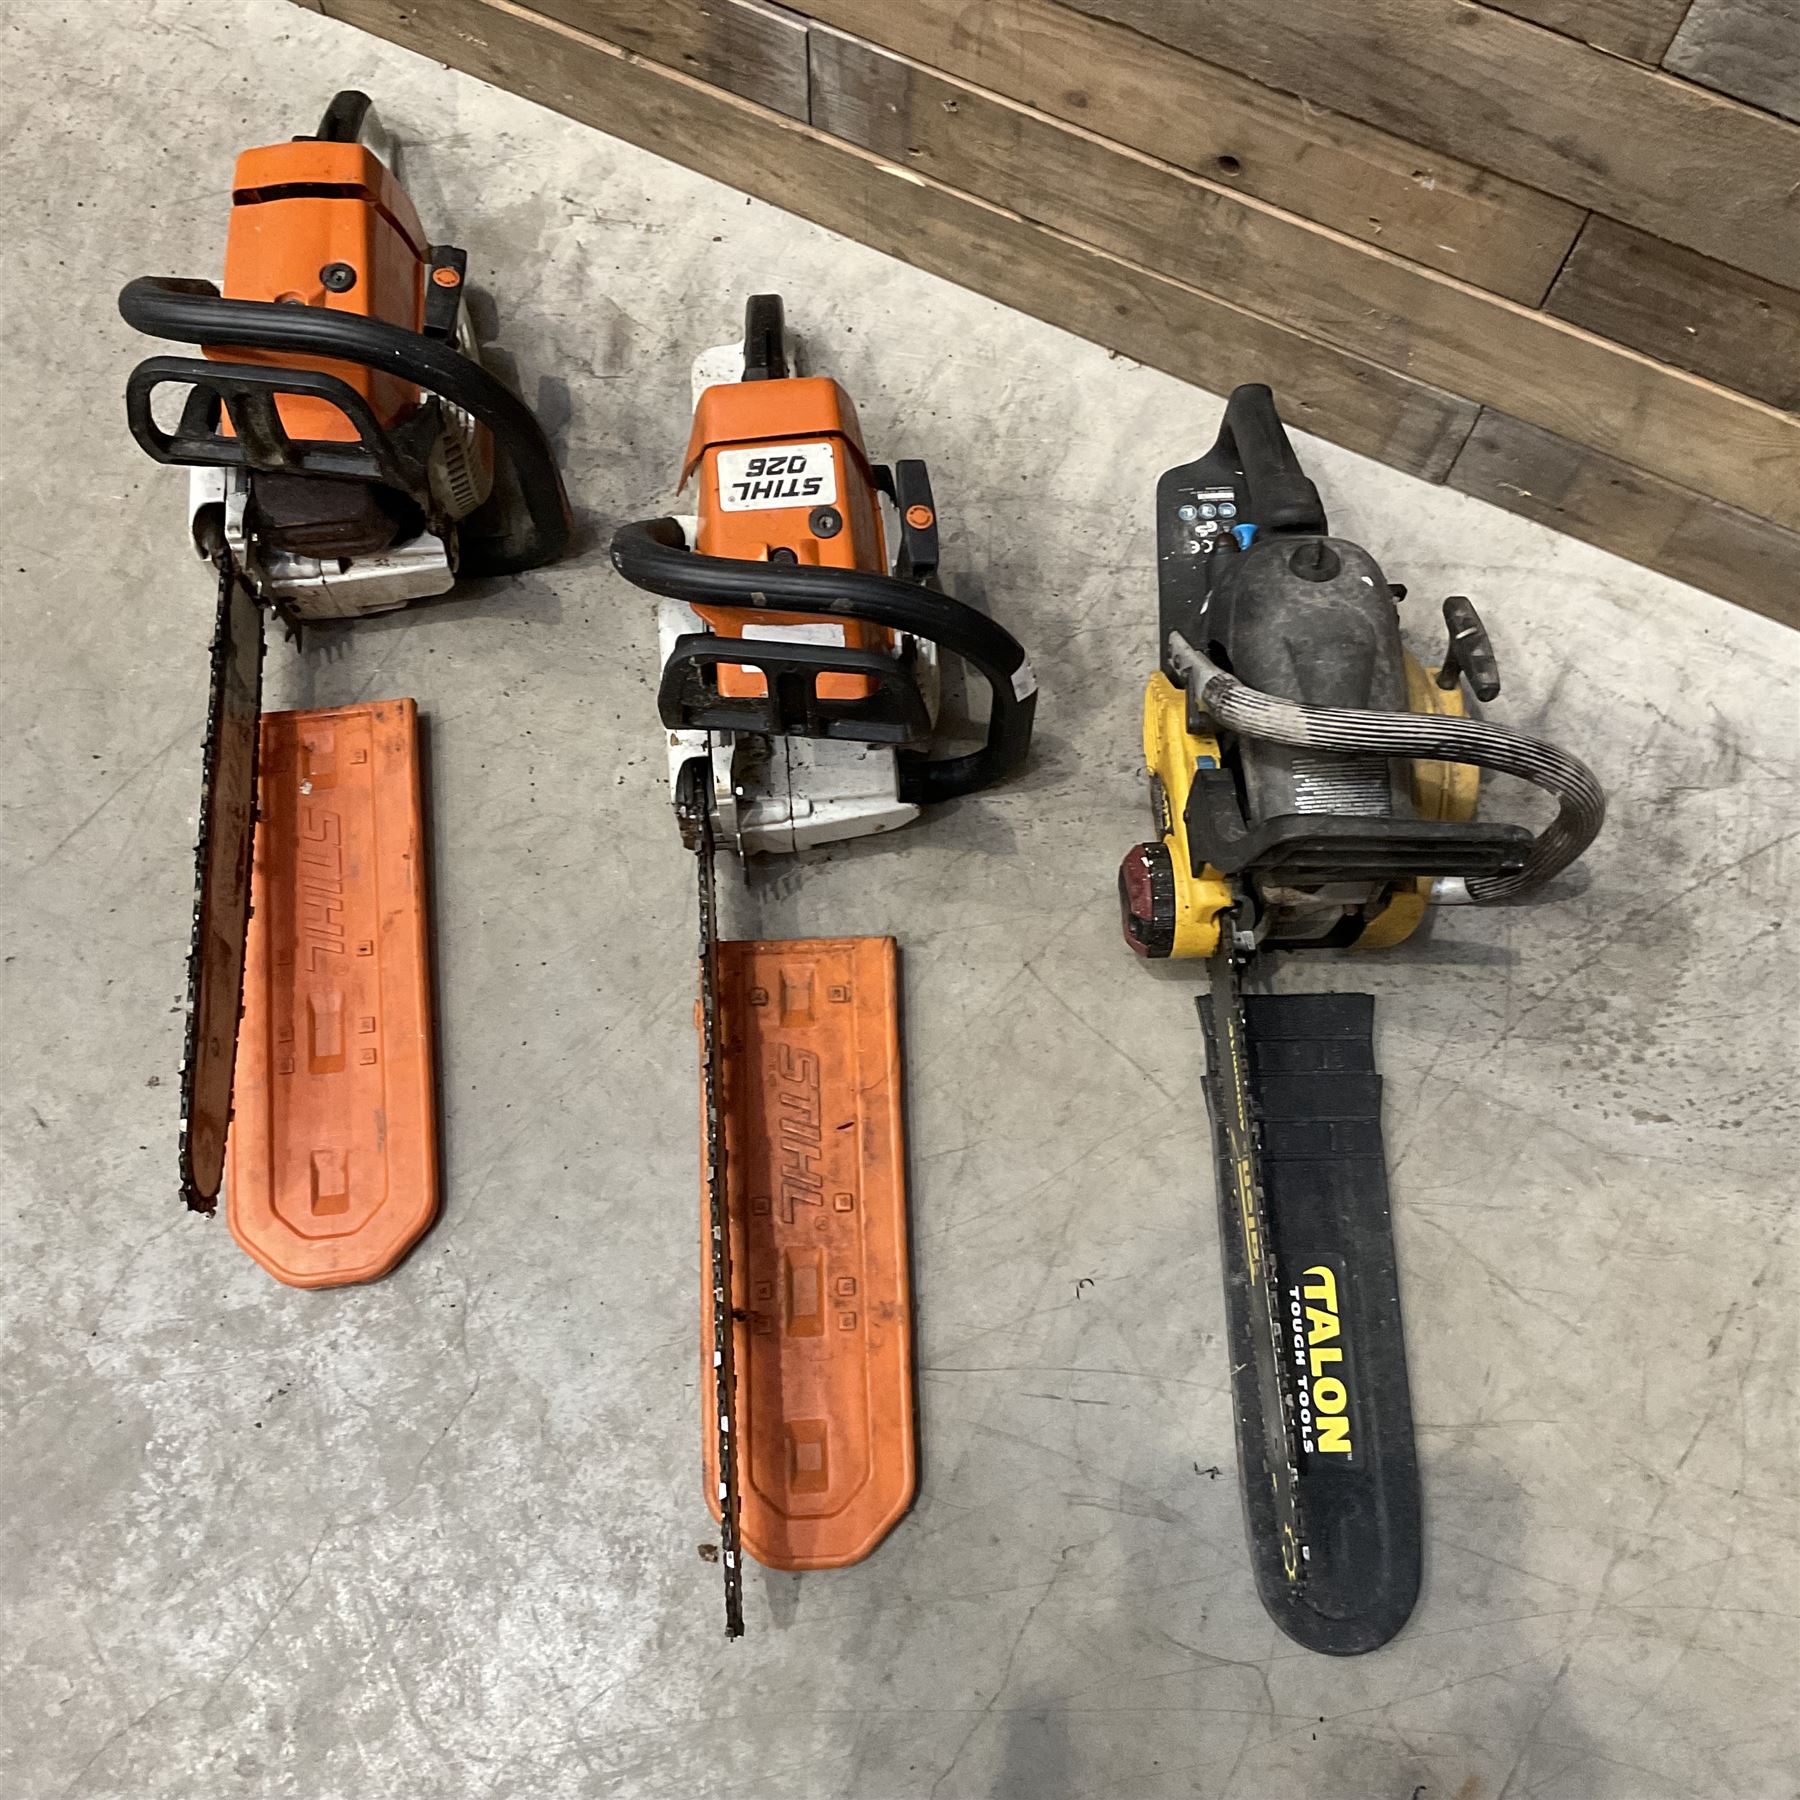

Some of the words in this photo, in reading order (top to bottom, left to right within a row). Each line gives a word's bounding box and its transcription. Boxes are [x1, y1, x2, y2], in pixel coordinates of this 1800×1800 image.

[731, 477, 823, 501] STIHL
[745, 455, 807, 477] 026
[302, 808, 344, 973] STIHL
[779, 1043, 823, 1225] STIHL
[1289, 1285, 1306, 1366] TOUGH
[1302, 1265, 1352, 1453] TALON
[1297, 1374, 1314, 1454] TOOLS
